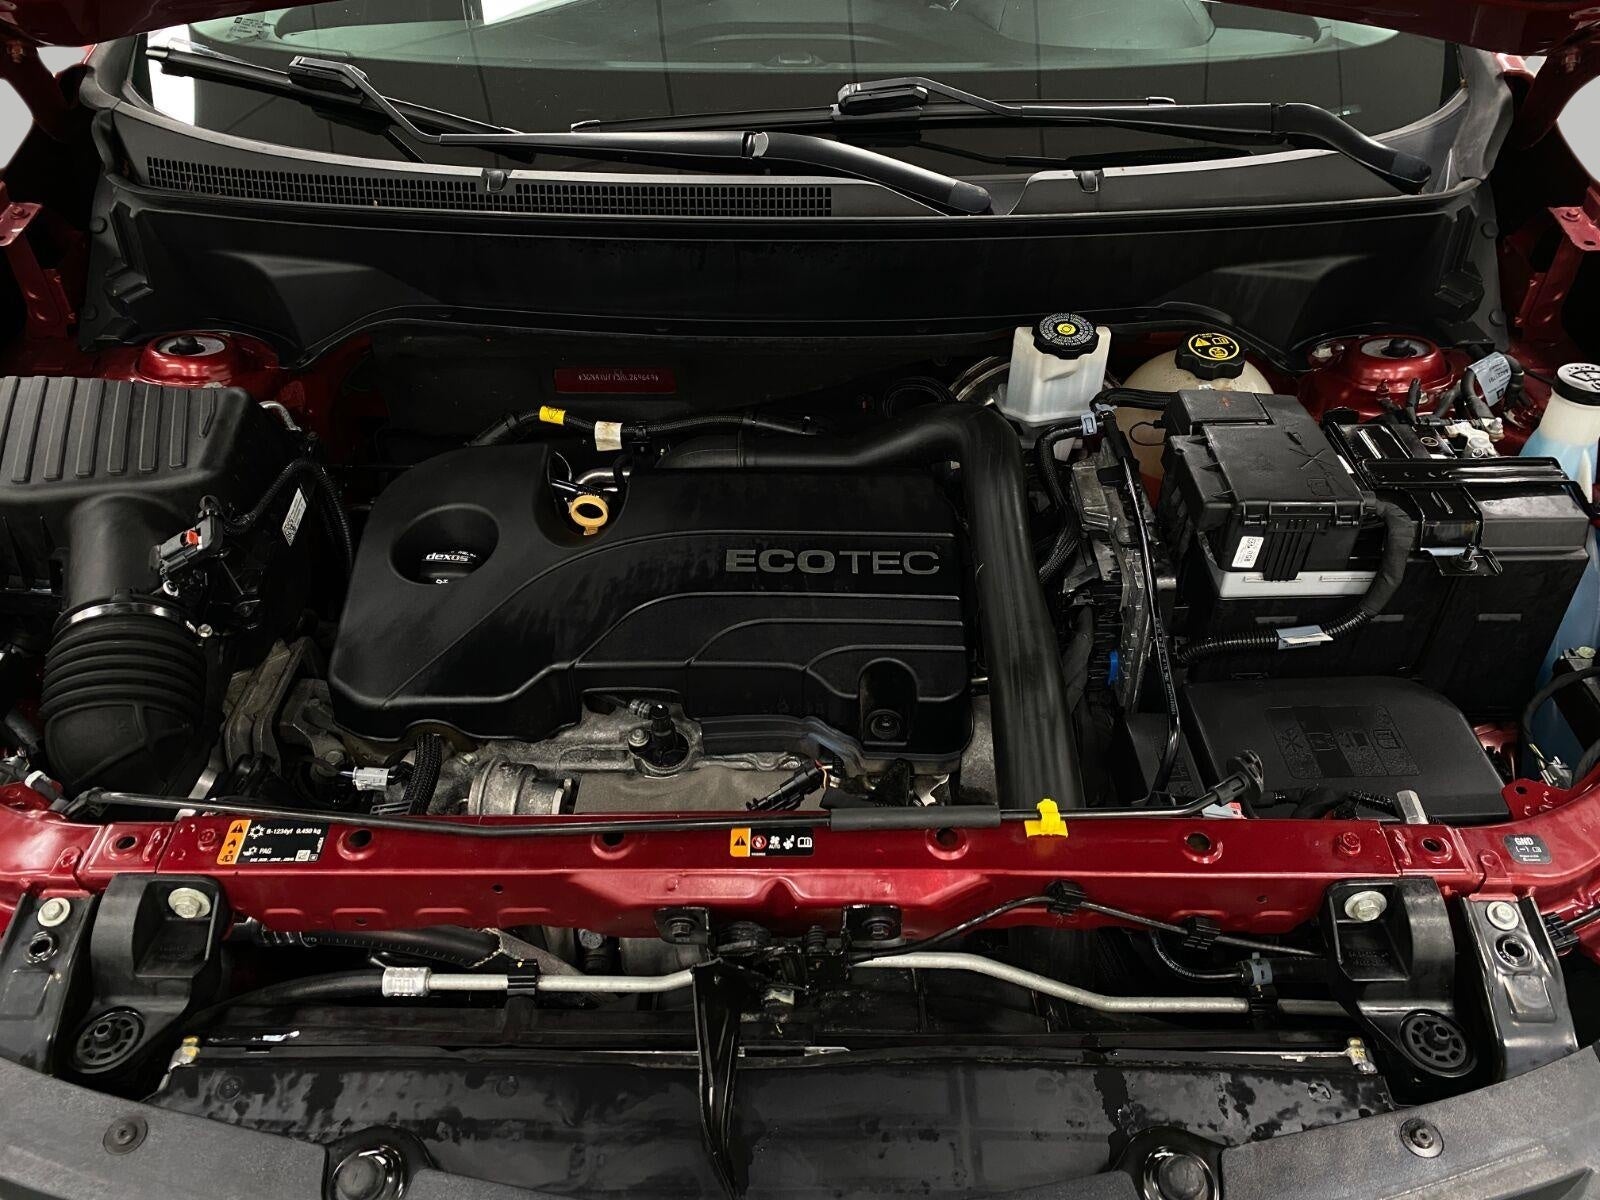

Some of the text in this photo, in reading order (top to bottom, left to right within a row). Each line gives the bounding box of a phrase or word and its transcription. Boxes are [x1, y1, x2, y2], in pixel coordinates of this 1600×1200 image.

[426, 552, 469, 562] dexos
[725, 549, 940, 575] ECOTEC
[1514, 837, 1534, 846] GND
[258, 847, 273, 855] PAG
